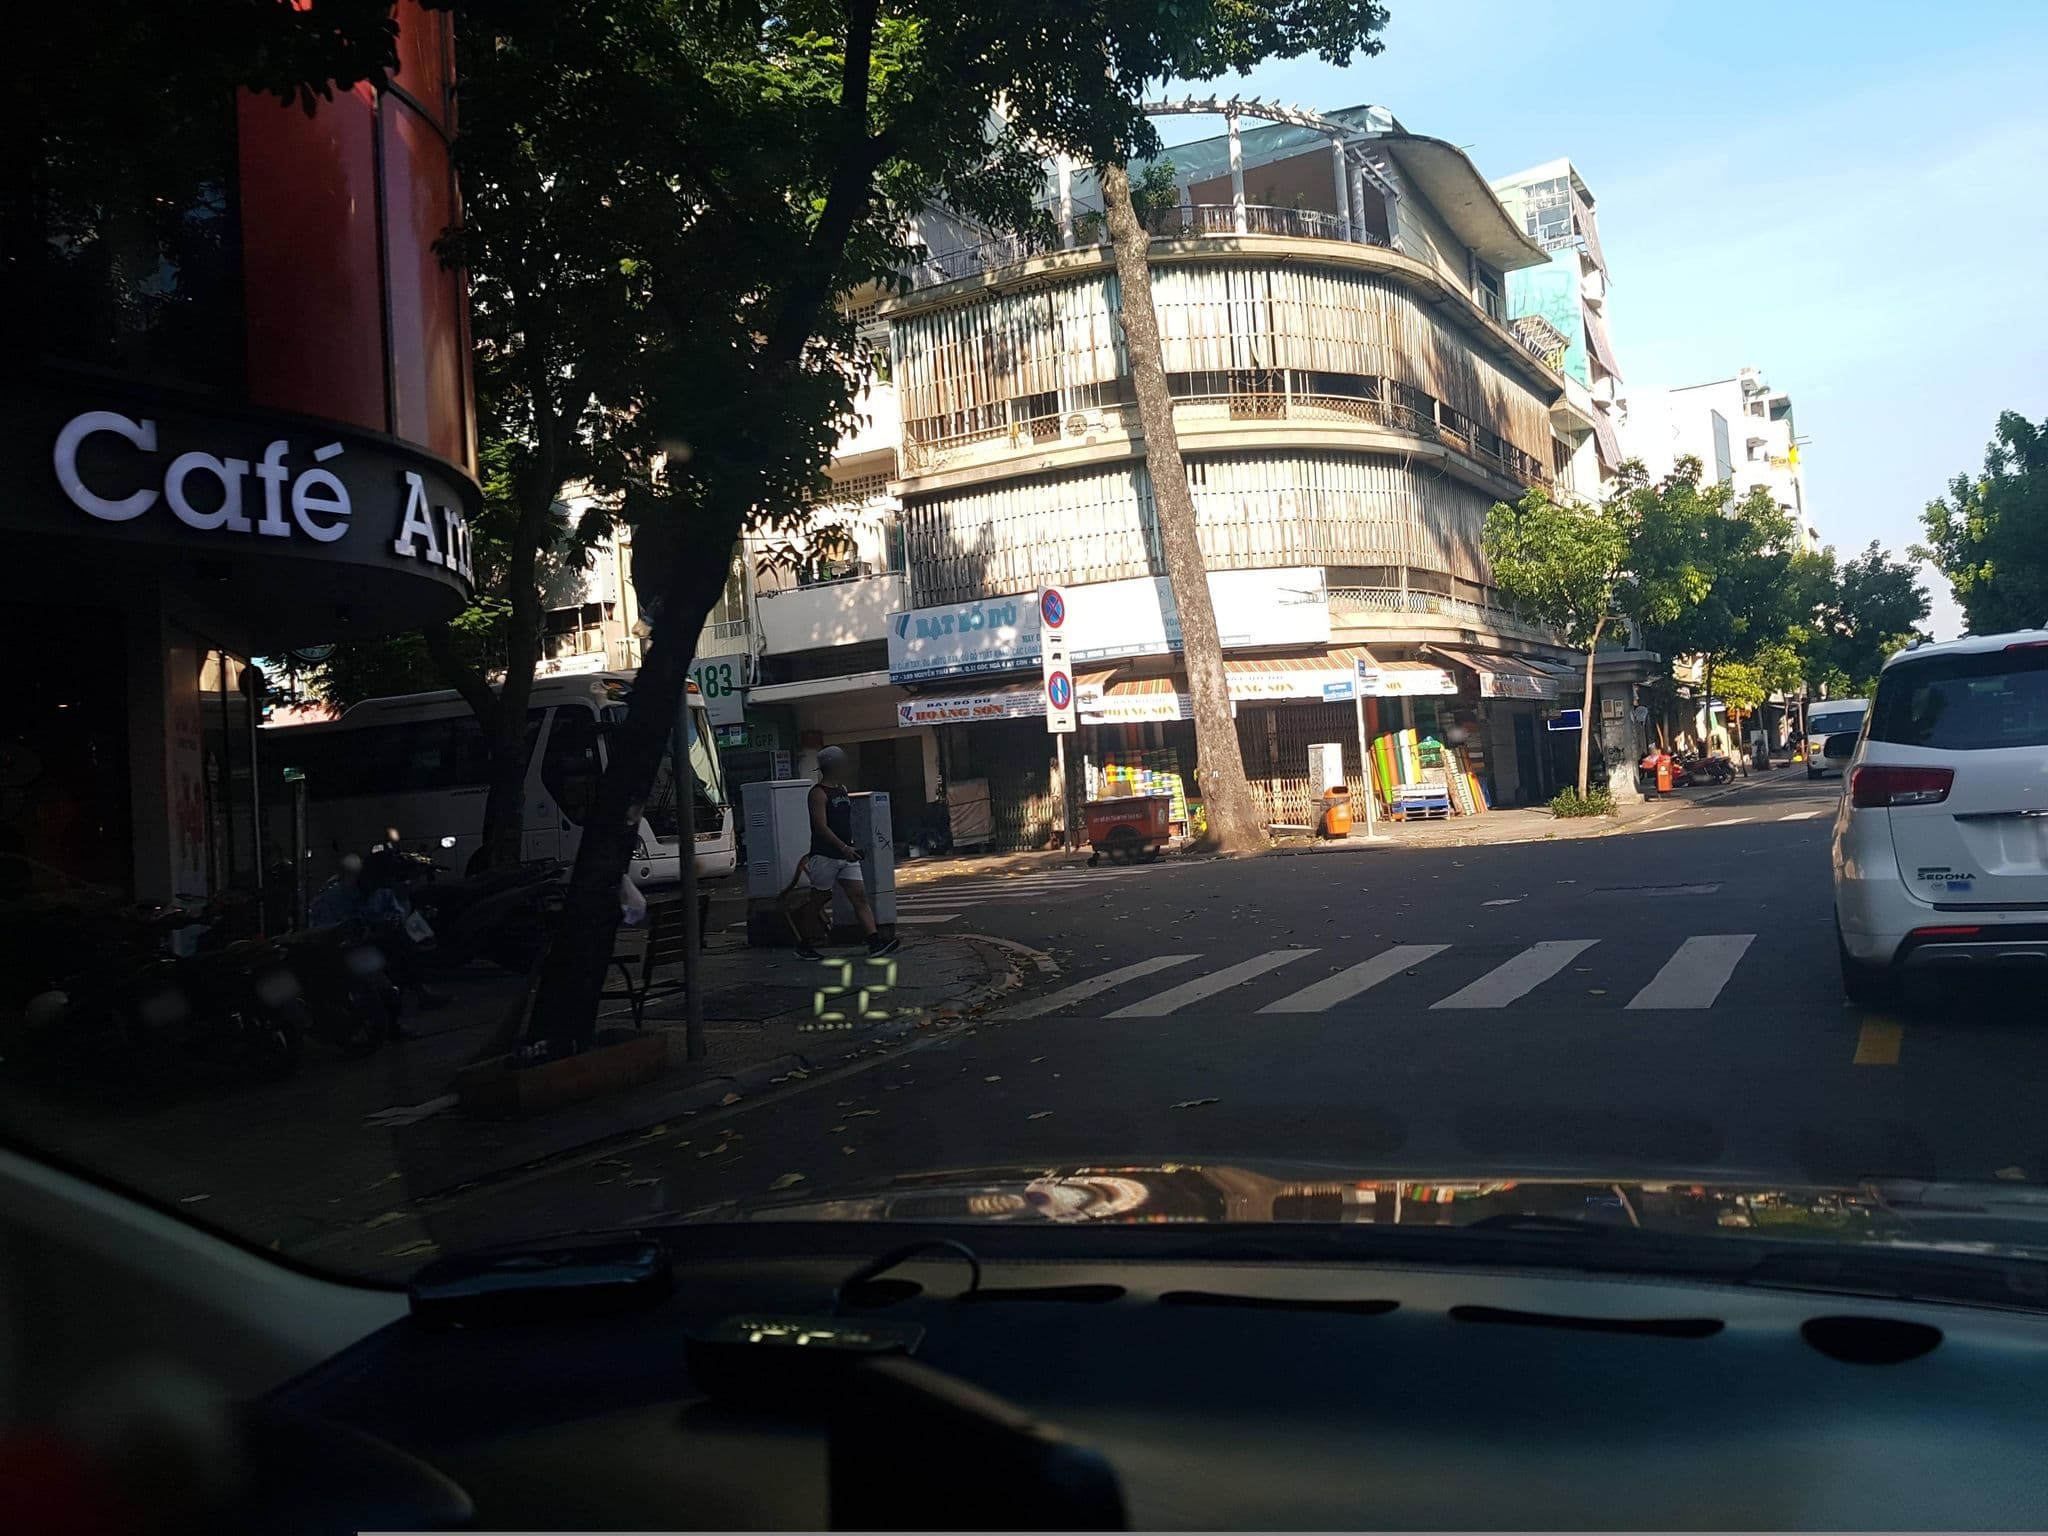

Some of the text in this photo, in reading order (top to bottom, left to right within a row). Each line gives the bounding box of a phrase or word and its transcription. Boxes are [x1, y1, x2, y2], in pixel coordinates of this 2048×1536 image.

[54, 410, 476, 592] Café Am
[694, 663, 733, 698] 183
[1917, 873, 1976, 881] SEDONA
[814, 957, 897, 1021] 22
